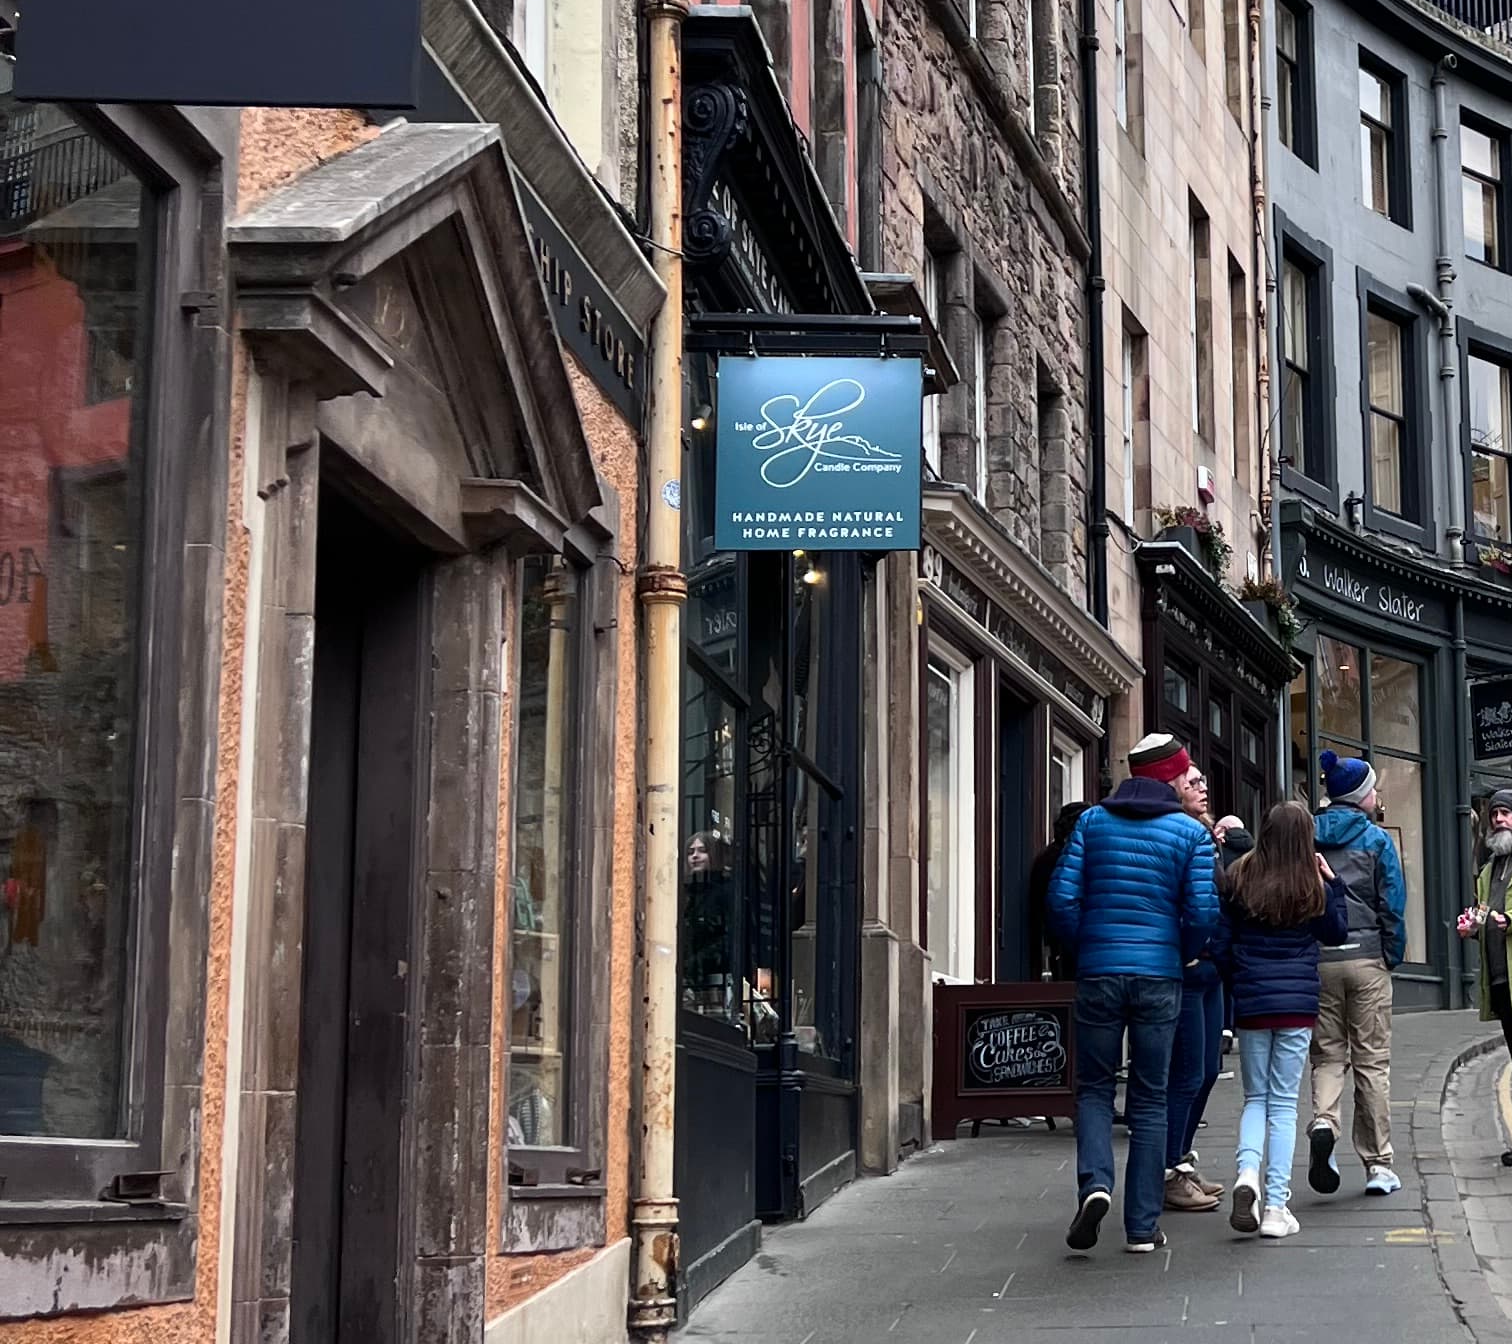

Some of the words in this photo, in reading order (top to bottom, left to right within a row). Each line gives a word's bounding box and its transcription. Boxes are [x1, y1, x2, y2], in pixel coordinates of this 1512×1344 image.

[581, 295, 634, 390] STORE
[735, 421, 754, 431] Isle
[751, 378, 868, 489] Skye
[755, 421, 767, 431] of
[813, 462, 851, 472] Candle
[852, 462, 902, 474] Company
[732, 511, 825, 523] HANDMADE
[831, 510, 904, 523] NATURAL
[742, 527, 791, 540] HOME
[797, 526, 894, 539] FRAGRANCE
[1323, 563, 1370, 604] Walker
[1378, 585, 1424, 622] Slater
[989, 1024, 1038, 1050] COFFEE
[979, 1042, 1035, 1068] Cakes
